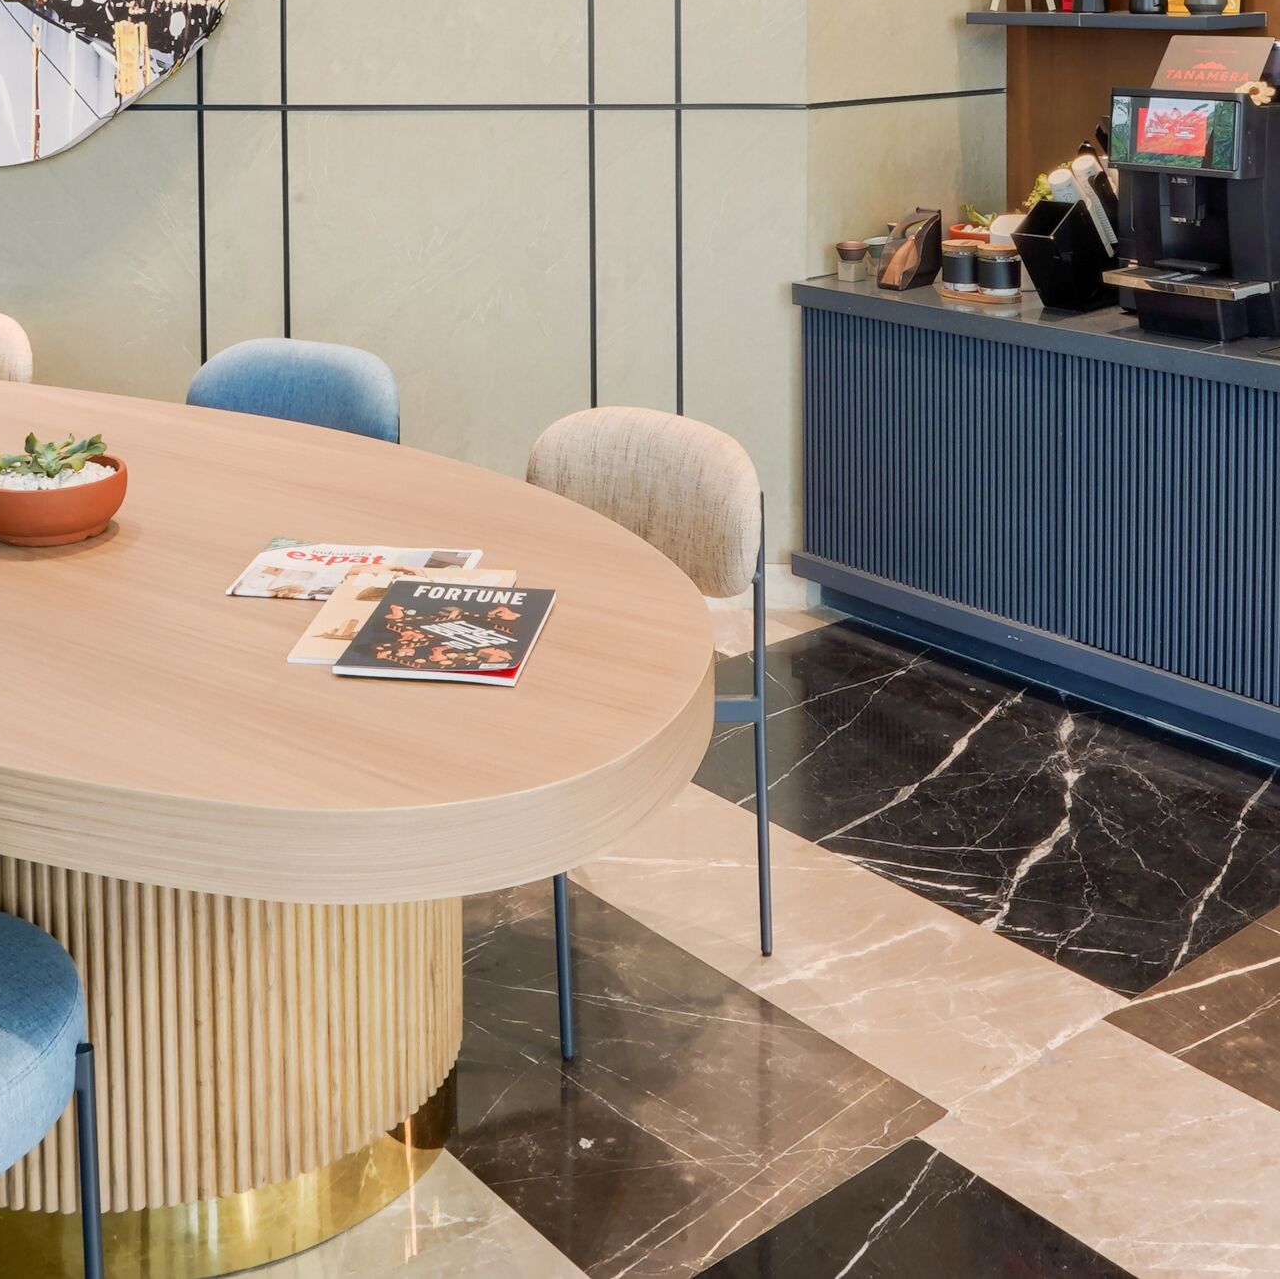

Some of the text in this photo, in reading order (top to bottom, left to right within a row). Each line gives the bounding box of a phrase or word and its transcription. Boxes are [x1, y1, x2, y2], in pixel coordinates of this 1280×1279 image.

[1166, 69, 1249, 82] TANAMERA
[286, 550, 386, 566] expat
[413, 585, 528, 606] FORTUNE
